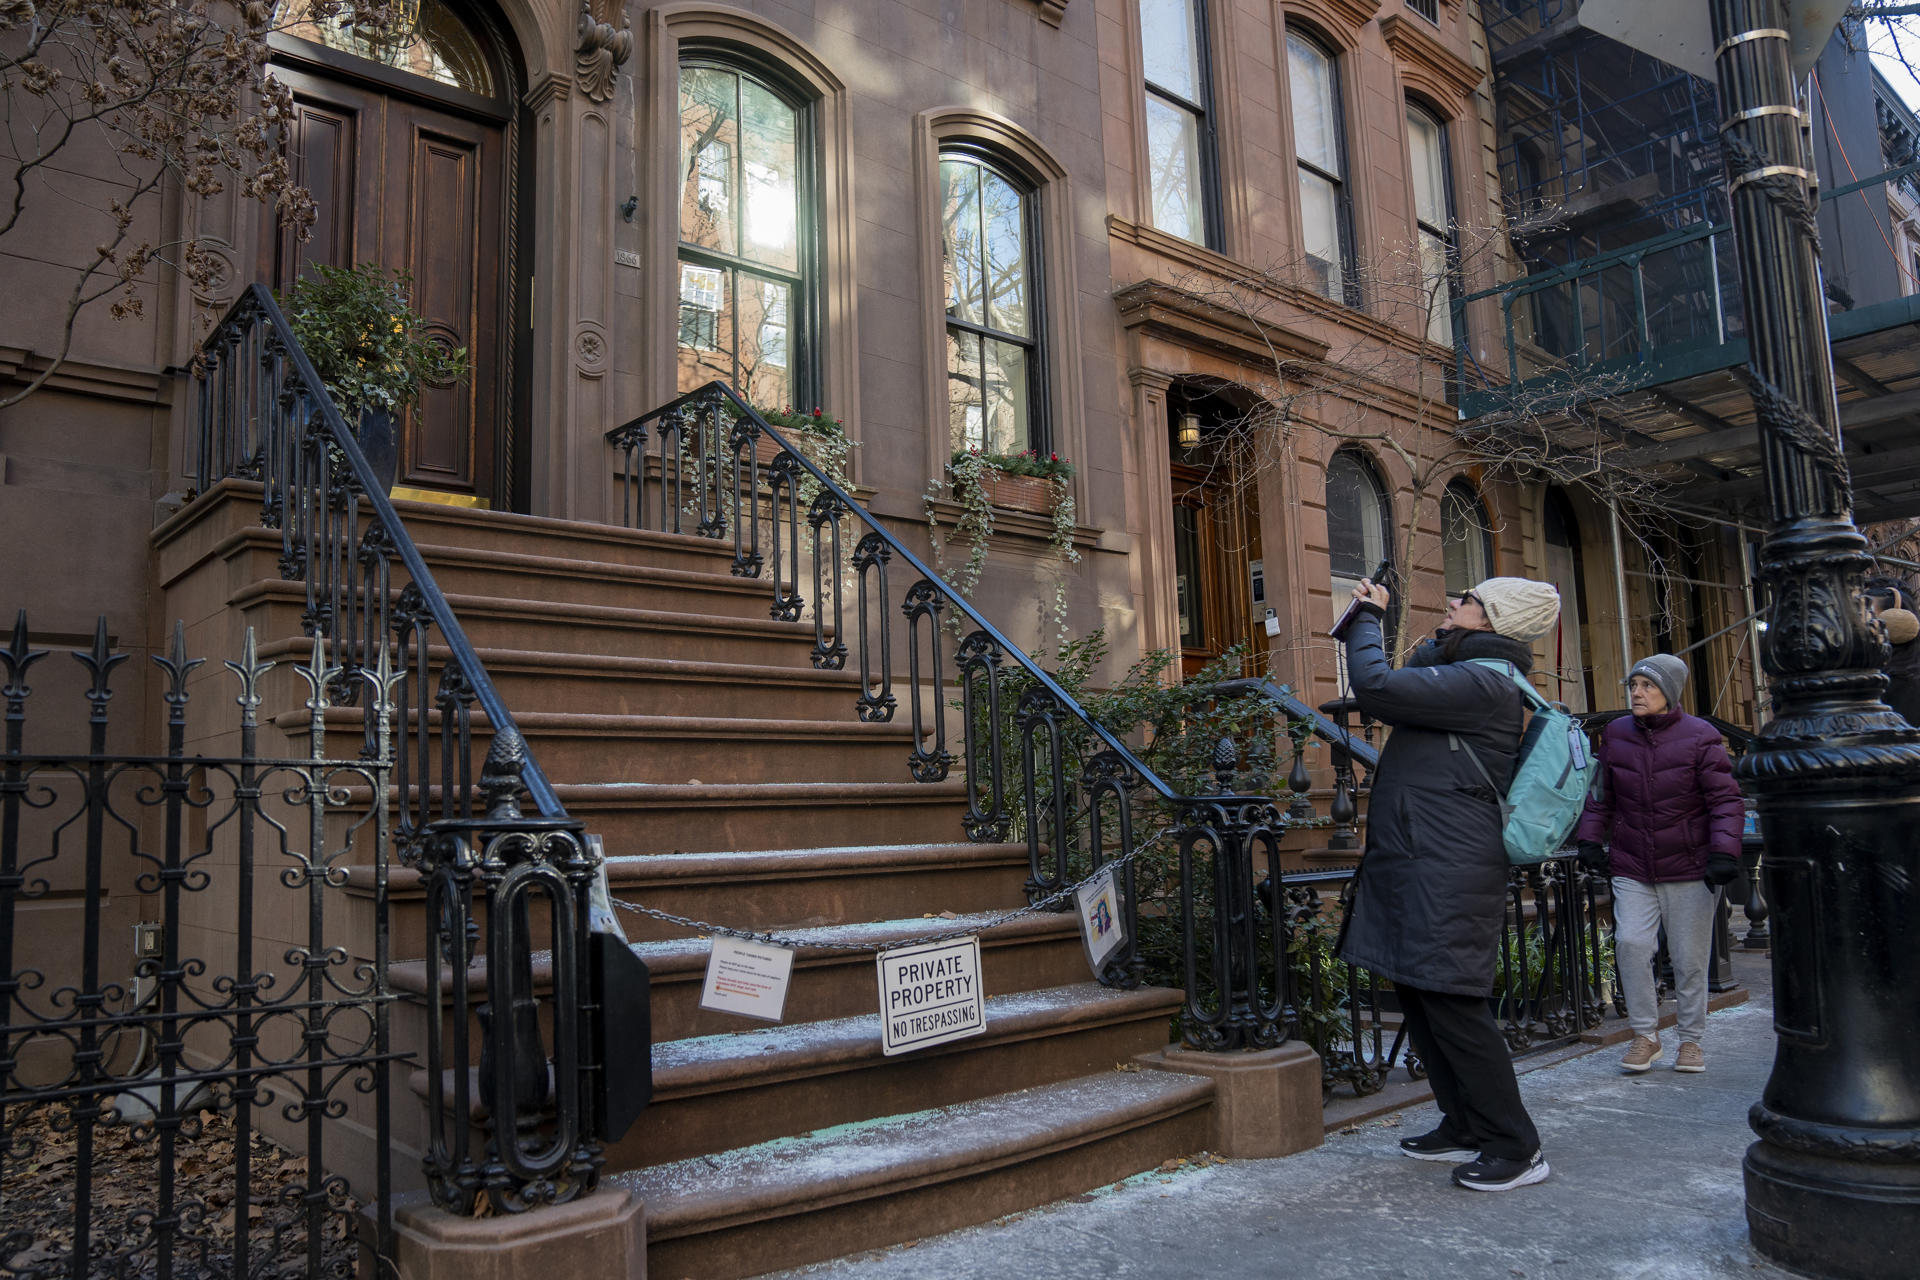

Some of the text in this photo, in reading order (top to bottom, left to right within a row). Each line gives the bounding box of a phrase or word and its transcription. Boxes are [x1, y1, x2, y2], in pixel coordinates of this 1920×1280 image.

[616, 251, 637, 265] 1866
[898, 955, 963, 985] PRIVATE
[891, 974, 972, 1010] PROPERTY
[893, 1005, 975, 1039] NO TRESPASSING
